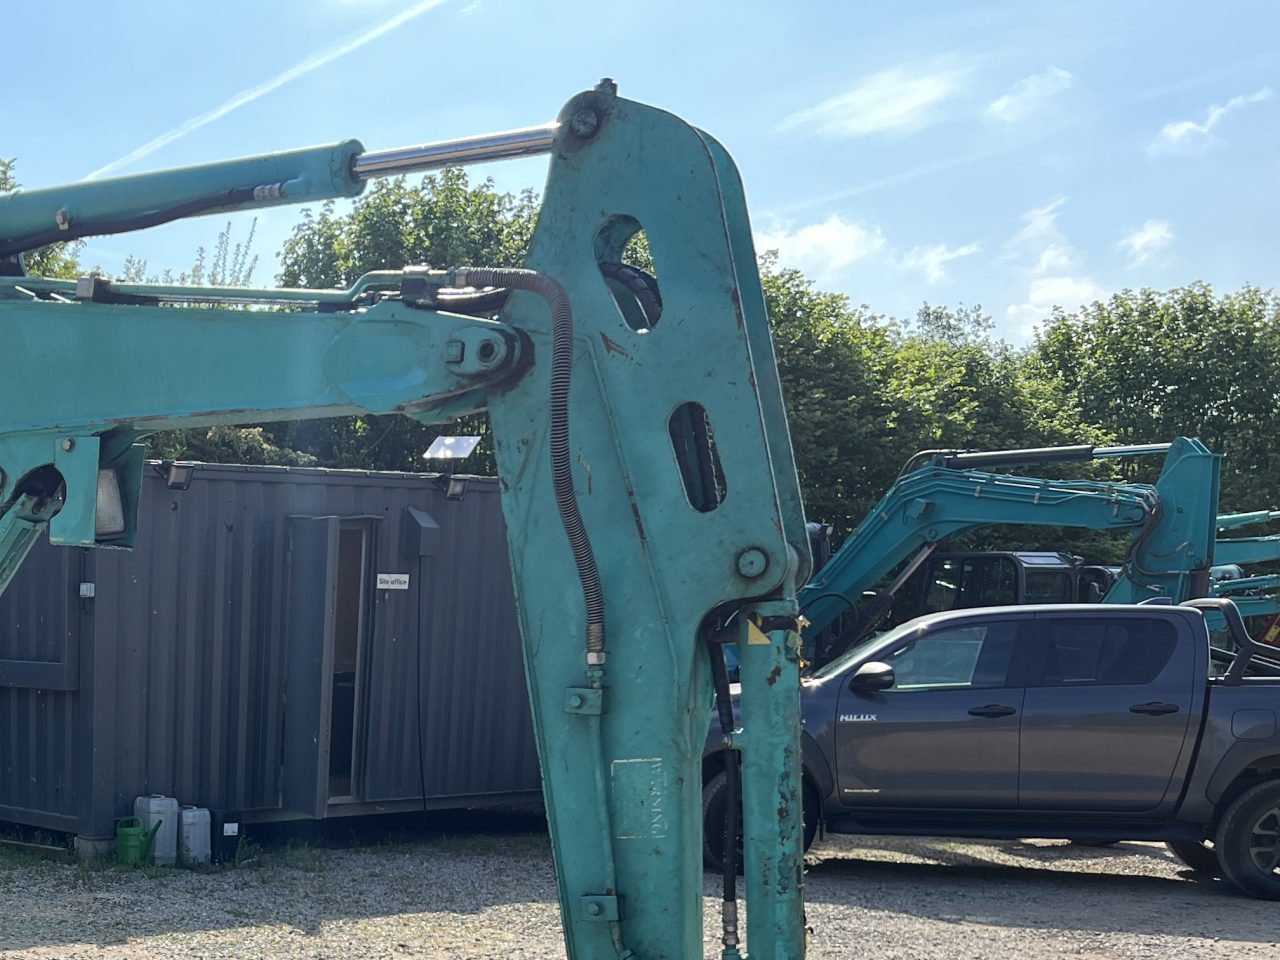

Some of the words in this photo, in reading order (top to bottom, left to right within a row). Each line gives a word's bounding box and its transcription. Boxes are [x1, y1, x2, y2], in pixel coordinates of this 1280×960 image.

[378, 577, 389, 585] Site
[390, 578, 407, 586] office
[839, 714, 877, 722] HILUX
[650, 762, 662, 834] WRNING
